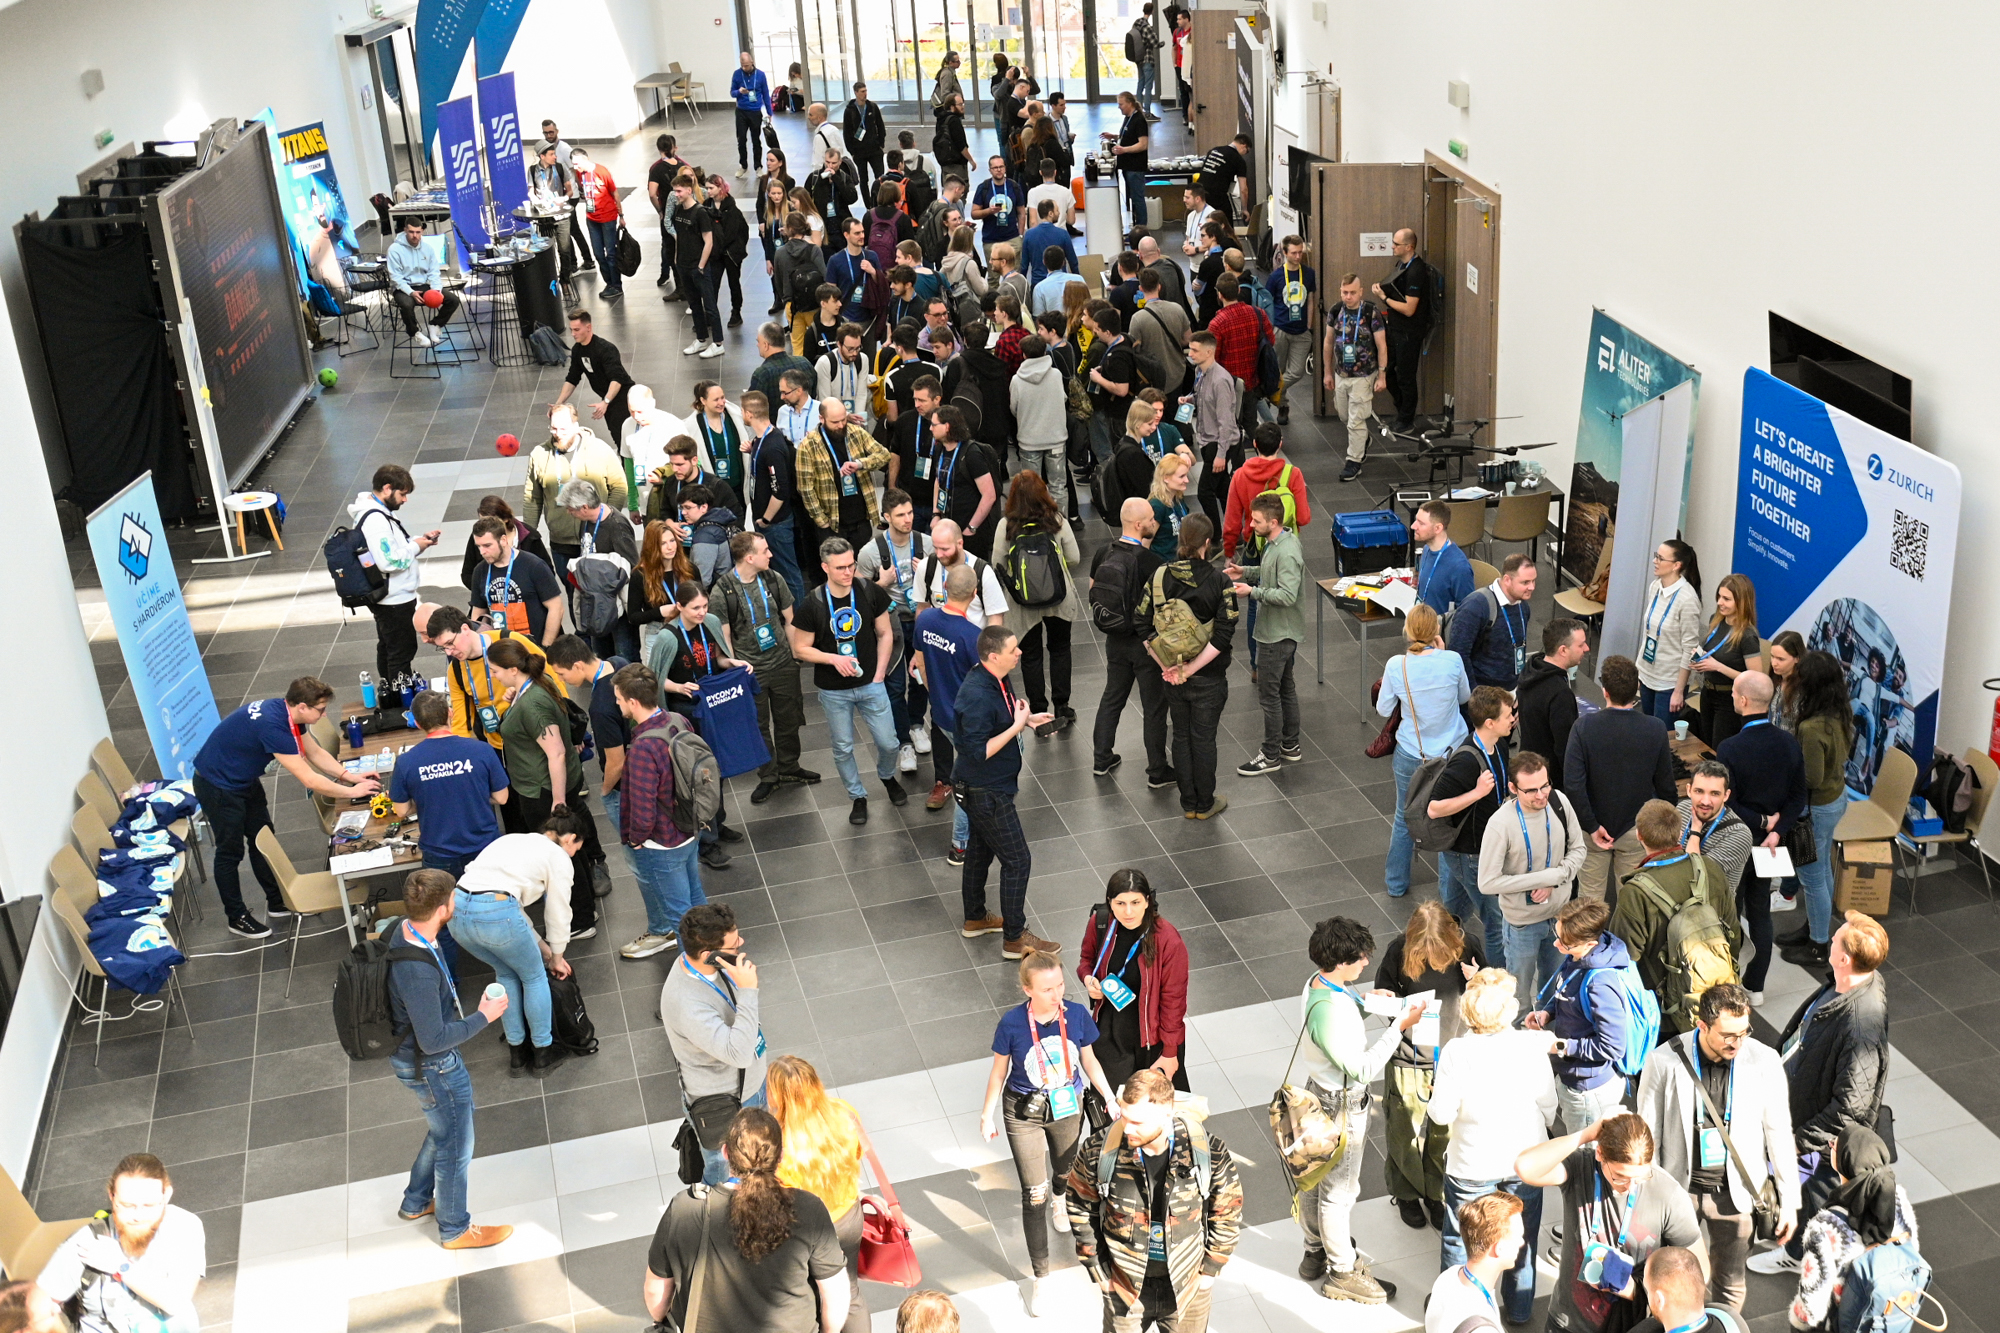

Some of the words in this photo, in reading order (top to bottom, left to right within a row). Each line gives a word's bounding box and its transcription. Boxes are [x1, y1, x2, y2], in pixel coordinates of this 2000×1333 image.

[279, 127, 329, 162] TITANS
[1617, 369, 1650, 397] TECHNOLOGIES
[1618, 348, 1650, 384] ALITER
[1754, 417, 1786, 448] LET'S
[1788, 437, 1835, 476] CREATE
[1753, 444, 1762, 461] A
[1764, 448, 1821, 495] BRIGHTER
[1888, 467, 1933, 503] ZURICH
[1752, 468, 1797, 508] FUTURE
[1750, 493, 1811, 543] TOGETHER
[1748, 526, 1763, 542] Focus
[1762, 537, 1770, 546] on
[136, 582, 161, 608] UČÍME
[138, 588, 176, 628] HARDVÉROM
[923, 629, 945, 645] PYCON
[943, 639, 956, 655] 24
[706, 688, 731, 703] PYCON
[730, 684, 744, 699] 24
[418, 761, 453, 775] PYCON
[453, 758, 474, 775] 24
[420, 770, 454, 781] SLOVAKIA
